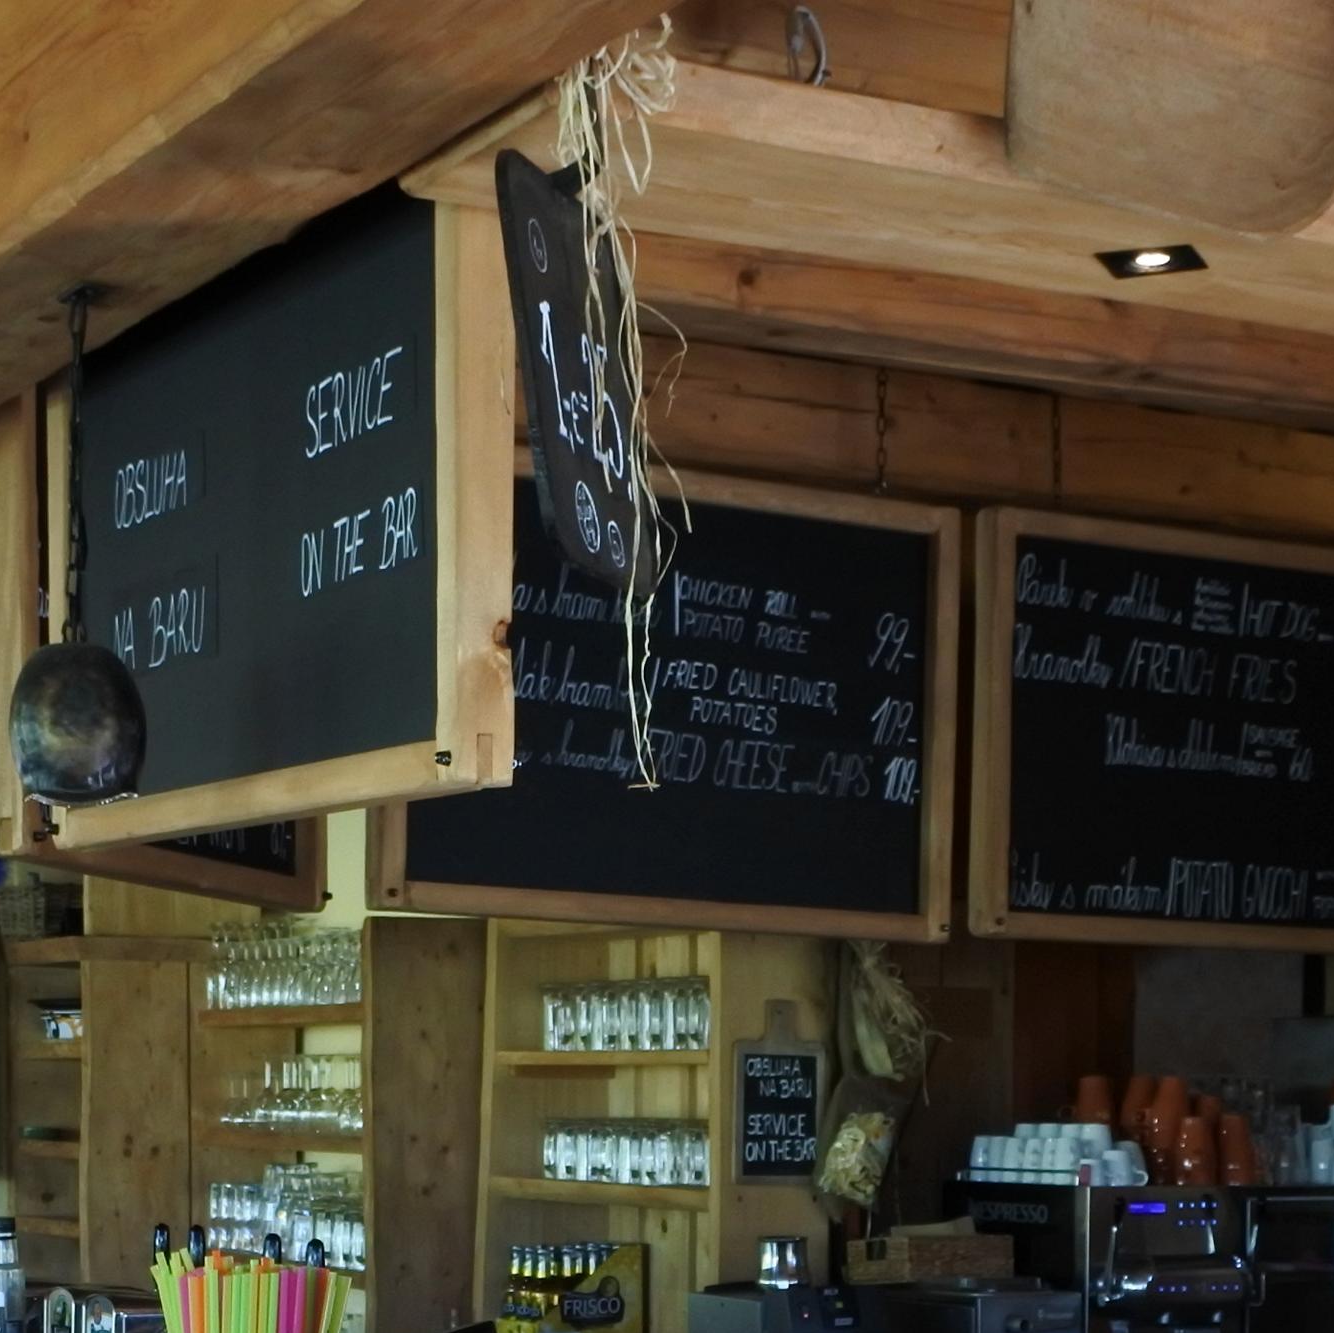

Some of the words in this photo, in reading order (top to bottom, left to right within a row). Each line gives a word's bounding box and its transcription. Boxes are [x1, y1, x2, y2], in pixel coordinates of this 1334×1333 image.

[305, 346, 403, 458] SERVICE
[115, 450, 187, 529] OBSLUHA
[301, 529, 324, 597] ON
[333, 509, 371, 582] THE
[379, 487, 417, 570] BAR
[679, 575, 753, 610] CHICKEN
[114, 607, 135, 670] NA
[149, 586, 205, 668] BARU
[681, 608, 745, 643] POTATO
[663, 659, 717, 691] FRIED
[728, 667, 838, 716] CAULIFLOWER,
[1227, 653, 1298, 705] FRIES
[689, 696, 778, 736] POTATOES
[714, 738, 795, 793] CHEESE
[817, 750, 874, 797] CHIPS
[746, 1056, 801, 1079] OBSLUHA
[759, 1080, 777, 1099] NA
[779, 1077, 813, 1100] BARU
[746, 1113, 807, 1138] SERVICE
[745, 1141, 766, 1162] ON
[768, 1142, 793, 1162] THE
[563, 1297, 621, 1316] FRISCO
